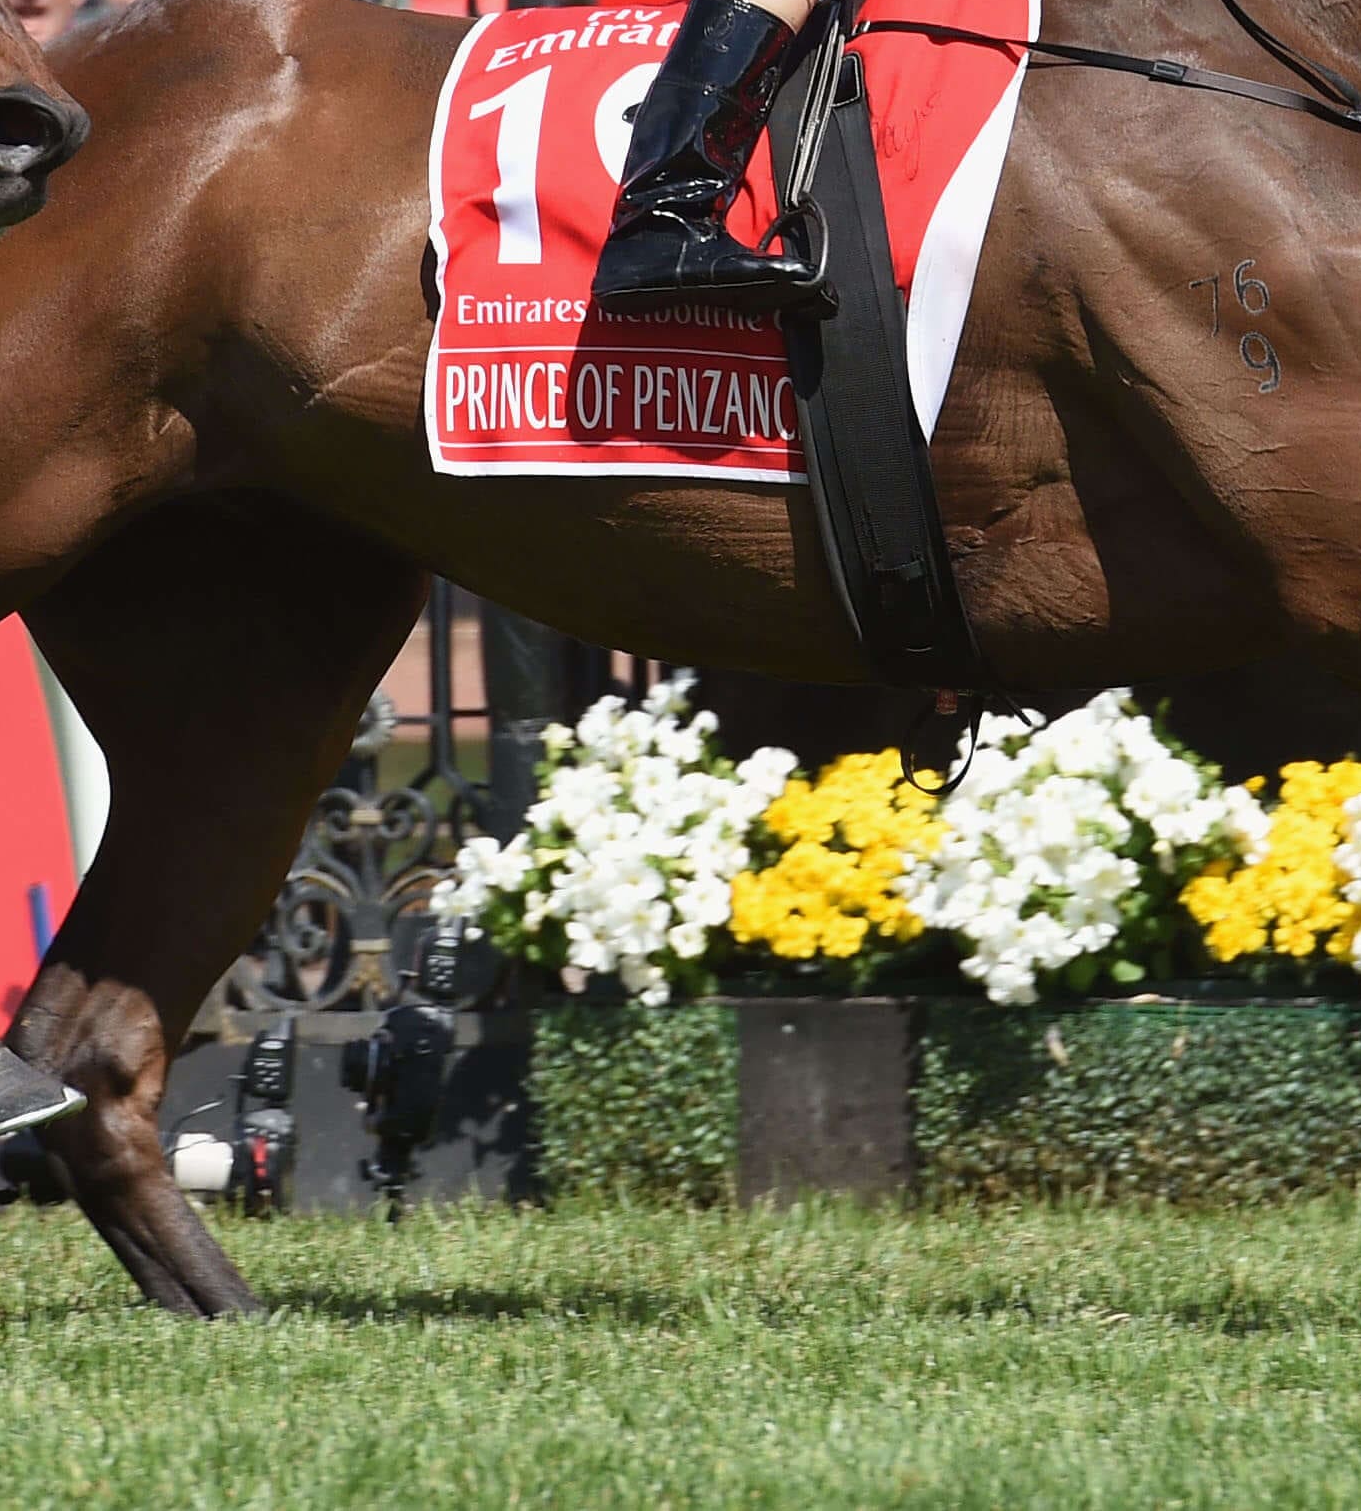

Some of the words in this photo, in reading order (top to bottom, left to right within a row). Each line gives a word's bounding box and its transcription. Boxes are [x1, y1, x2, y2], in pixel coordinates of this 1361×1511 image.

[456, 293, 587, 325] Emirates
[1239, 332, 1281, 394] 9
[445, 362, 568, 432] PRINCE
[576, 363, 624, 430] OF
[634, 365, 801, 441] PENZANC
